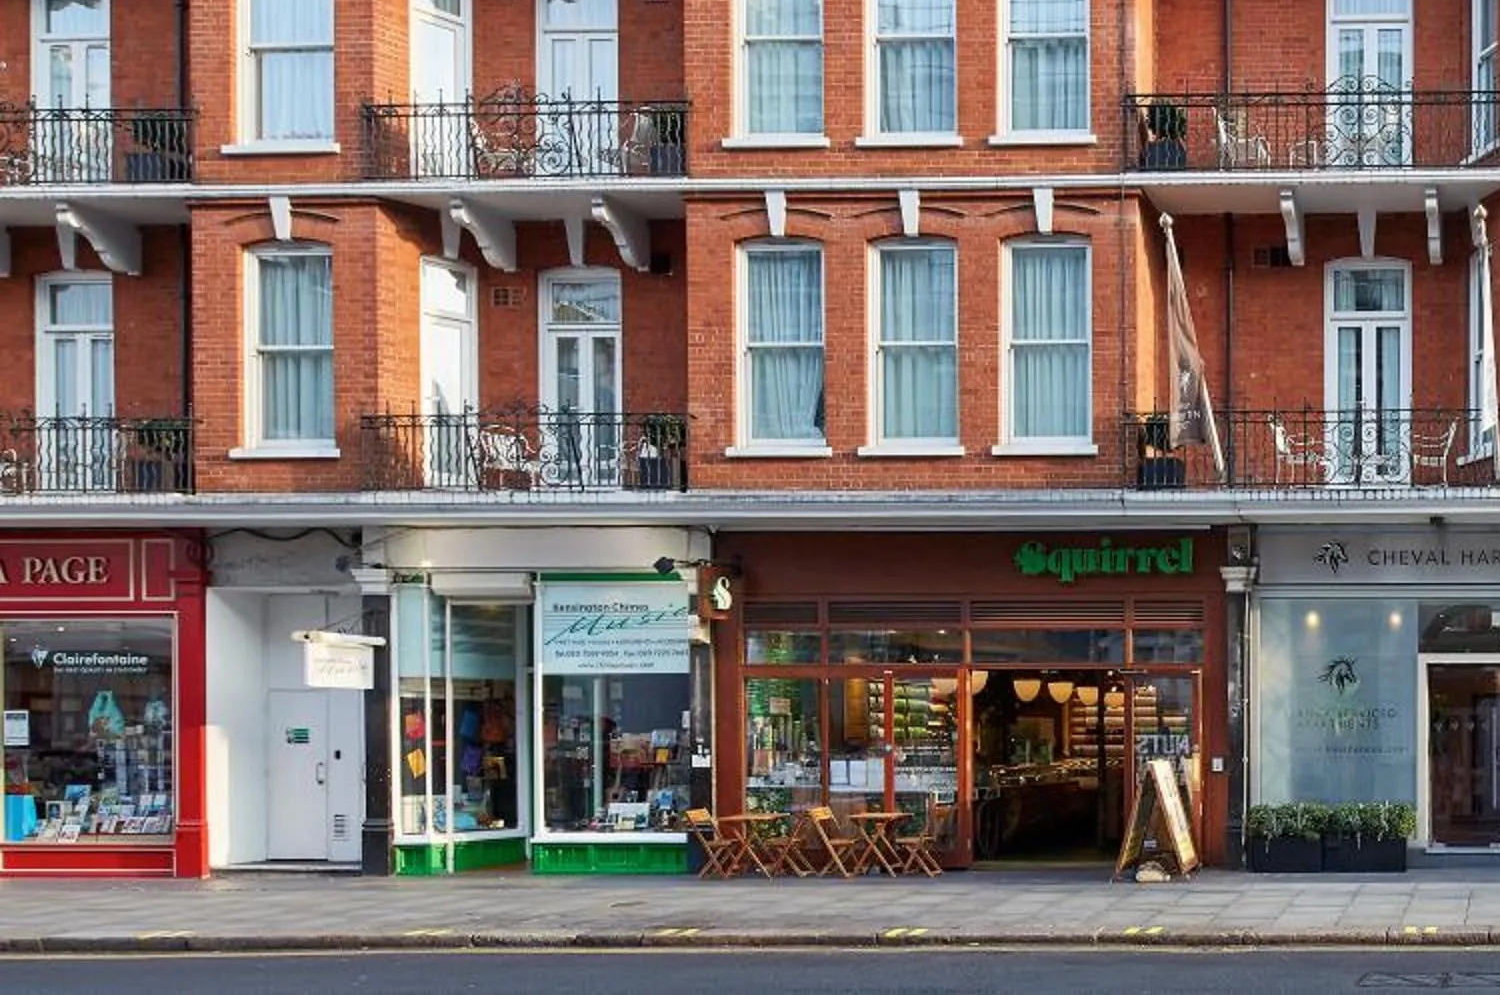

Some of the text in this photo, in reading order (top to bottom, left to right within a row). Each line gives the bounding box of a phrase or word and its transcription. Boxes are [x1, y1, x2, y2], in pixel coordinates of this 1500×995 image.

[1014, 538, 1193, 582] Squirrel
[1367, 549, 1450, 566] CHEVAL
[22, 556, 109, 584] PAGE
[53, 652, 148, 666] Clairefontaine
